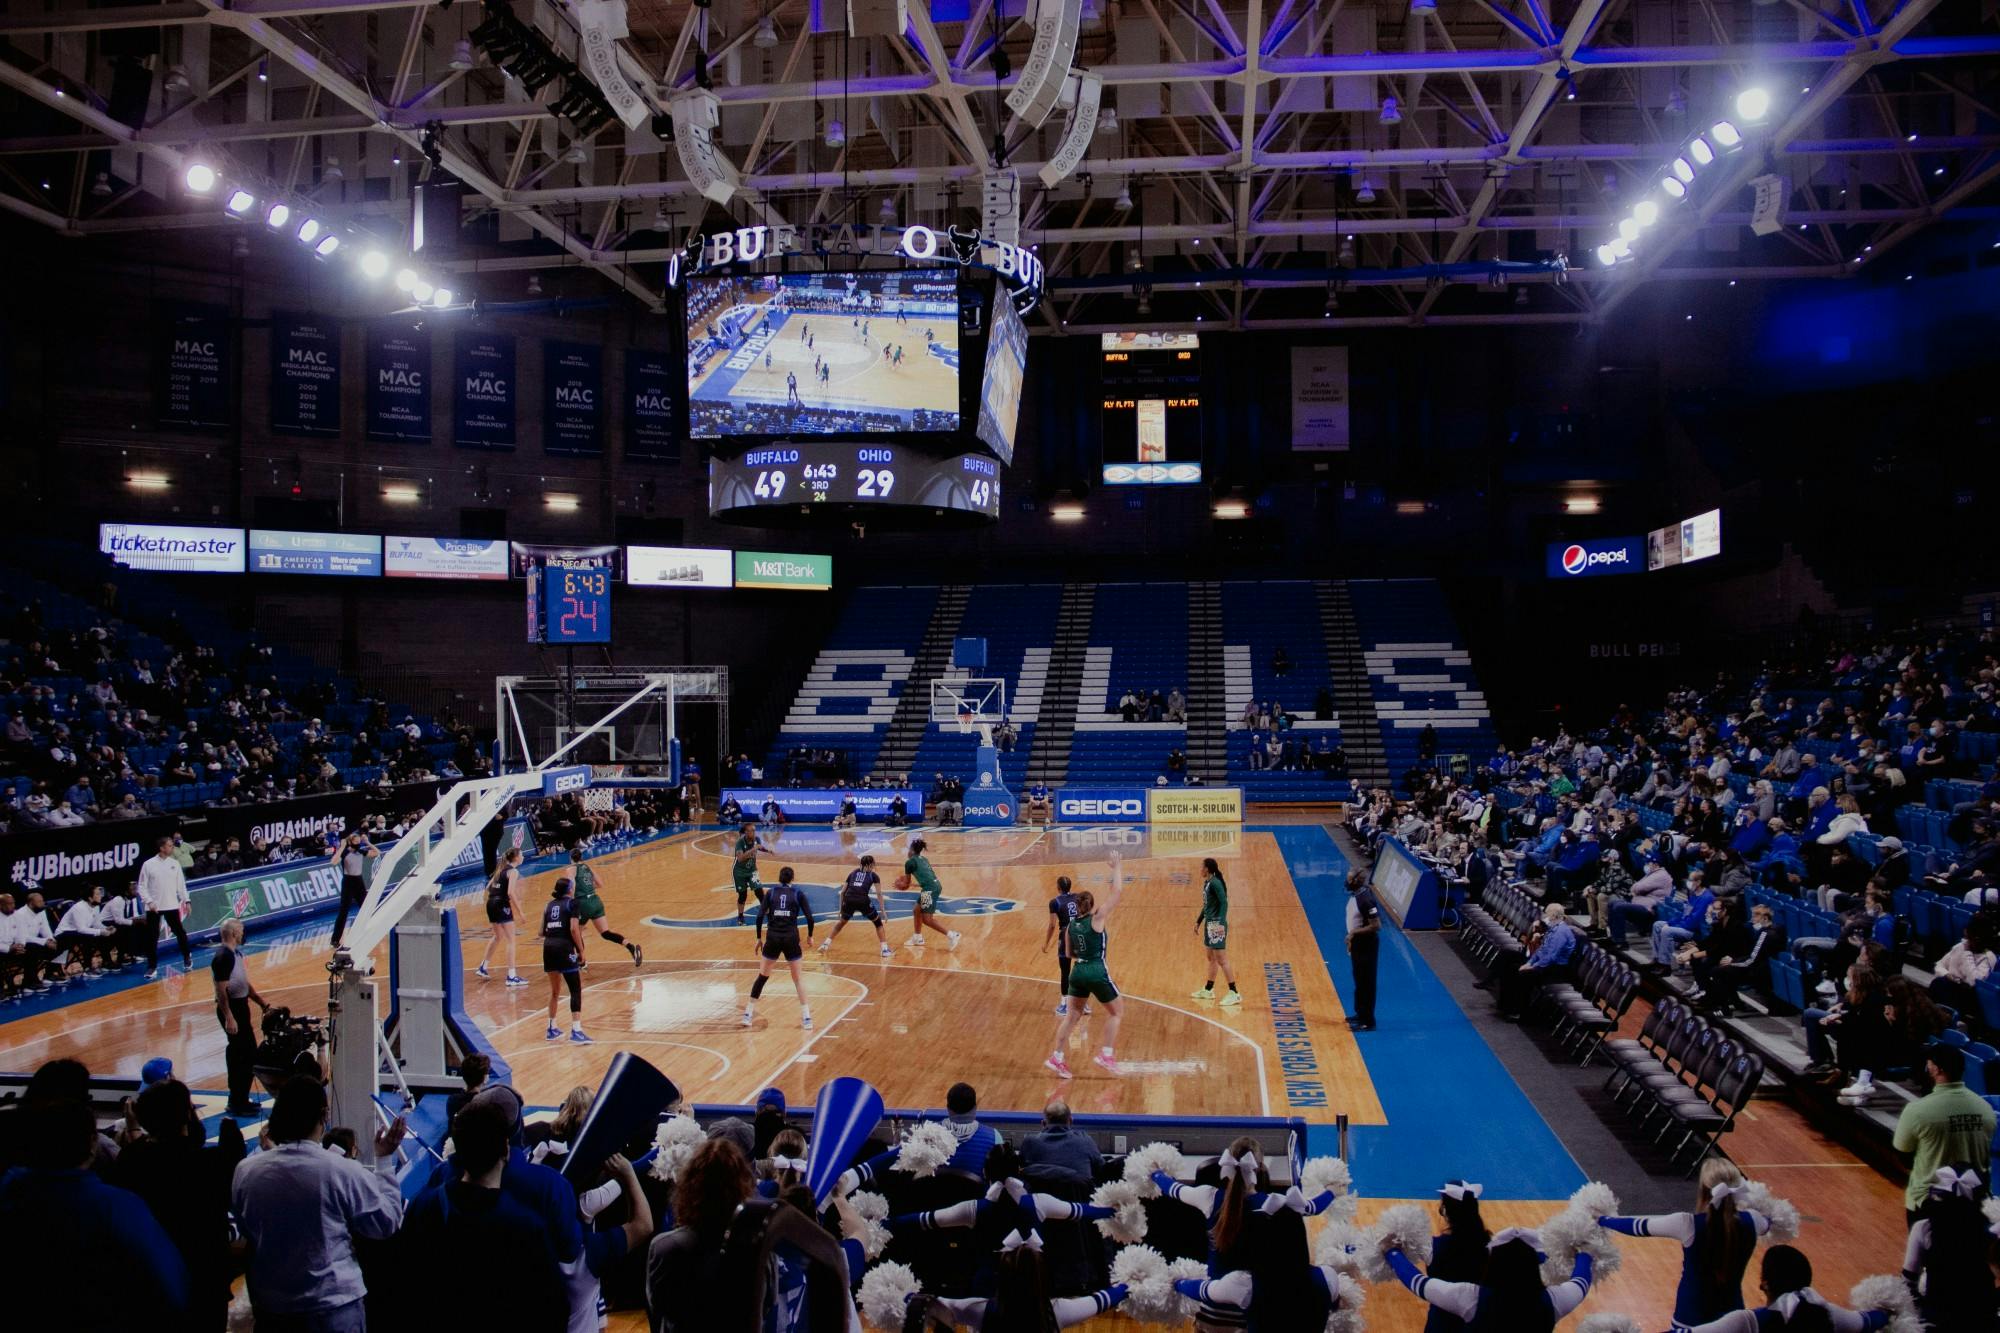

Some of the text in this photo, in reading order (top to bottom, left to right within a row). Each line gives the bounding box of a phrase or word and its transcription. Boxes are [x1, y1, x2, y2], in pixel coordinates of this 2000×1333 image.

[711, 223, 938, 266] BUFFALO
[175, 339, 215, 356] MAC
[288, 347, 328, 365] MAC
[1105, 353, 1128, 361] BUFFALO
[171, 361, 219, 371] CHAMPIONS
[286, 369, 331, 381] CHAMPIONS
[379, 368, 422, 387] MAC
[379, 385, 422, 395] CHAMPIONS
[466, 377, 507, 395] MAC
[466, 393, 507, 403] CHAMPIONS
[555, 386, 594, 403] MAC
[556, 401, 594, 411] CHAMPIONS
[635, 393, 672, 411] MAC
[378, 412, 423, 422] TOURNAMENT
[391, 406, 410, 414] NCAA
[635, 409, 672, 417] CHAMPIONS
[465, 420, 507, 429] TOURNAMENT
[746, 449, 995, 475] BUFFALO OHIO BUFFALO
[754, 470, 786, 499] 49
[803, 464, 837, 479] 6:43
[857, 469, 895, 497] 29
[970, 479, 990, 507] 49
[812, 480, 829, 490] 3RD
[813, 491, 826, 503] 24
[110, 533, 236, 554] ticketmaster
[389, 551, 423, 560] BUFFALO
[753, 561, 815, 578] M&T Bank
[564, 573, 605, 595] 6:43
[560, 597, 597, 635] 24
[1590, 643, 1631, 657] BULL
[556, 773, 585, 791] GEICO
[859, 796, 882, 804] United
[1061, 800, 1142, 816] GEICO
[1156, 803, 1236, 815] SCOTCH-N-SIRLOIN
[11, 842, 140, 884] #UBhornsUP
[1067, 901, 1077, 916] 2
[1263, 962, 1329, 1107] NEW YORK'S PUBLIC POWERHOUSE
[1948, 1113, 1983, 1124] EVENT
[1949, 1123, 1984, 1133] STAFF
